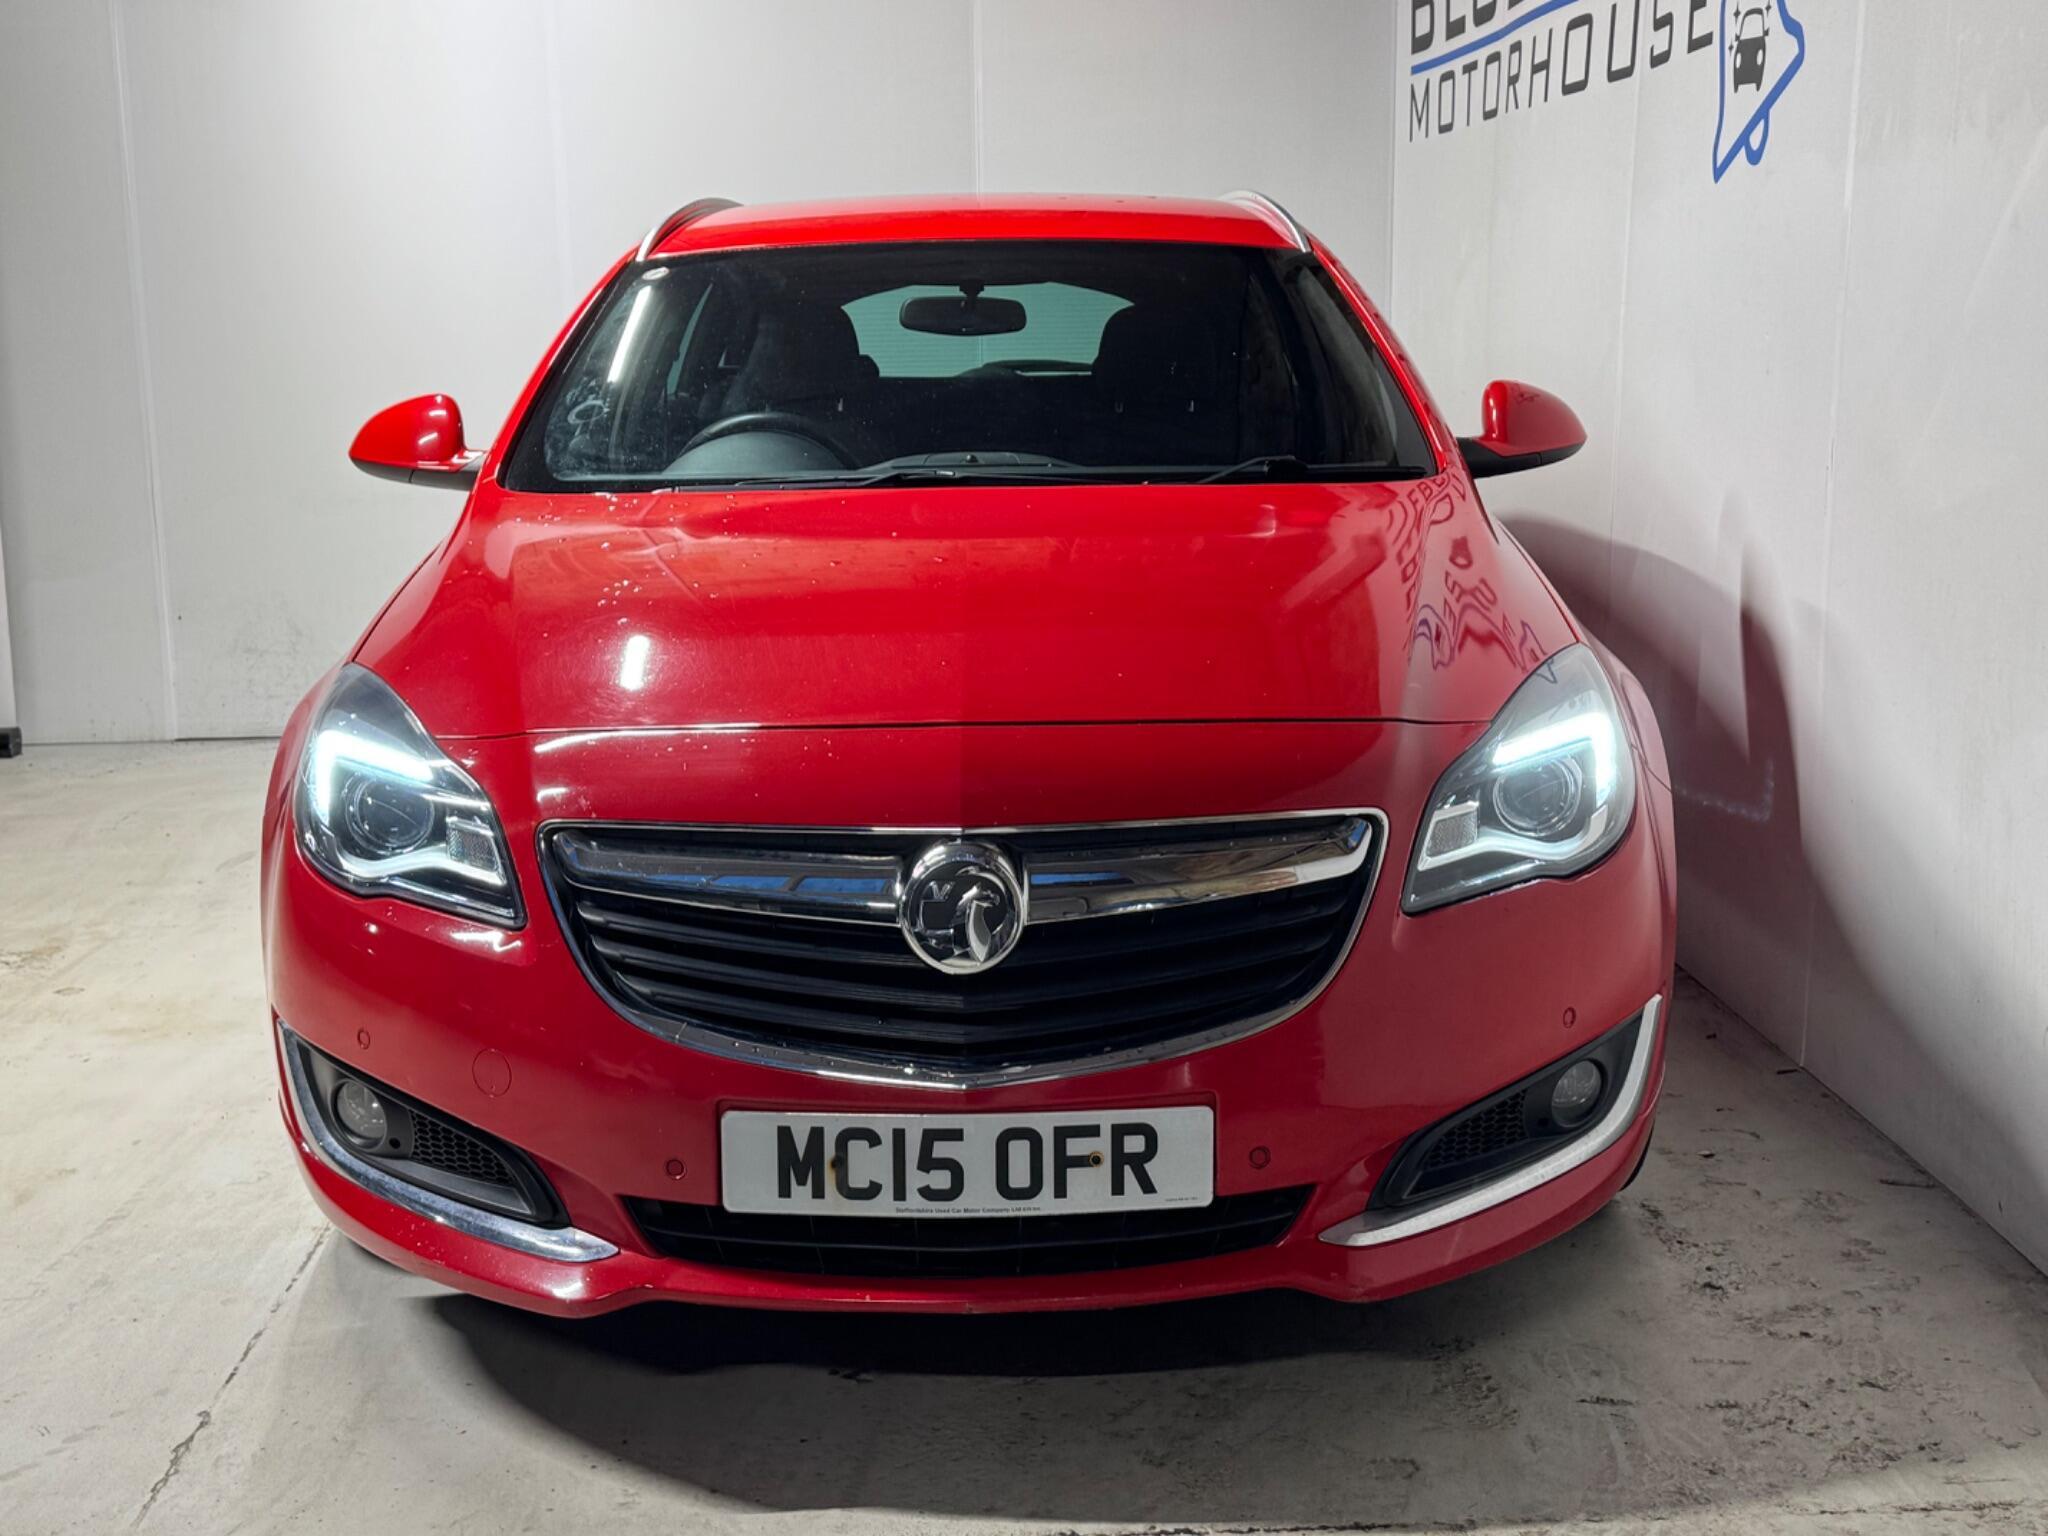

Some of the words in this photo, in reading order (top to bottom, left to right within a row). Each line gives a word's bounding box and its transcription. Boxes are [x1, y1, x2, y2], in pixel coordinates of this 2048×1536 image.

[1411, 0, 1525, 55] BL
[1409, 0, 1713, 142] MOTORHOUSE
[777, 1126, 964, 1202] MC15
[995, 1122, 1158, 1201] OFR
